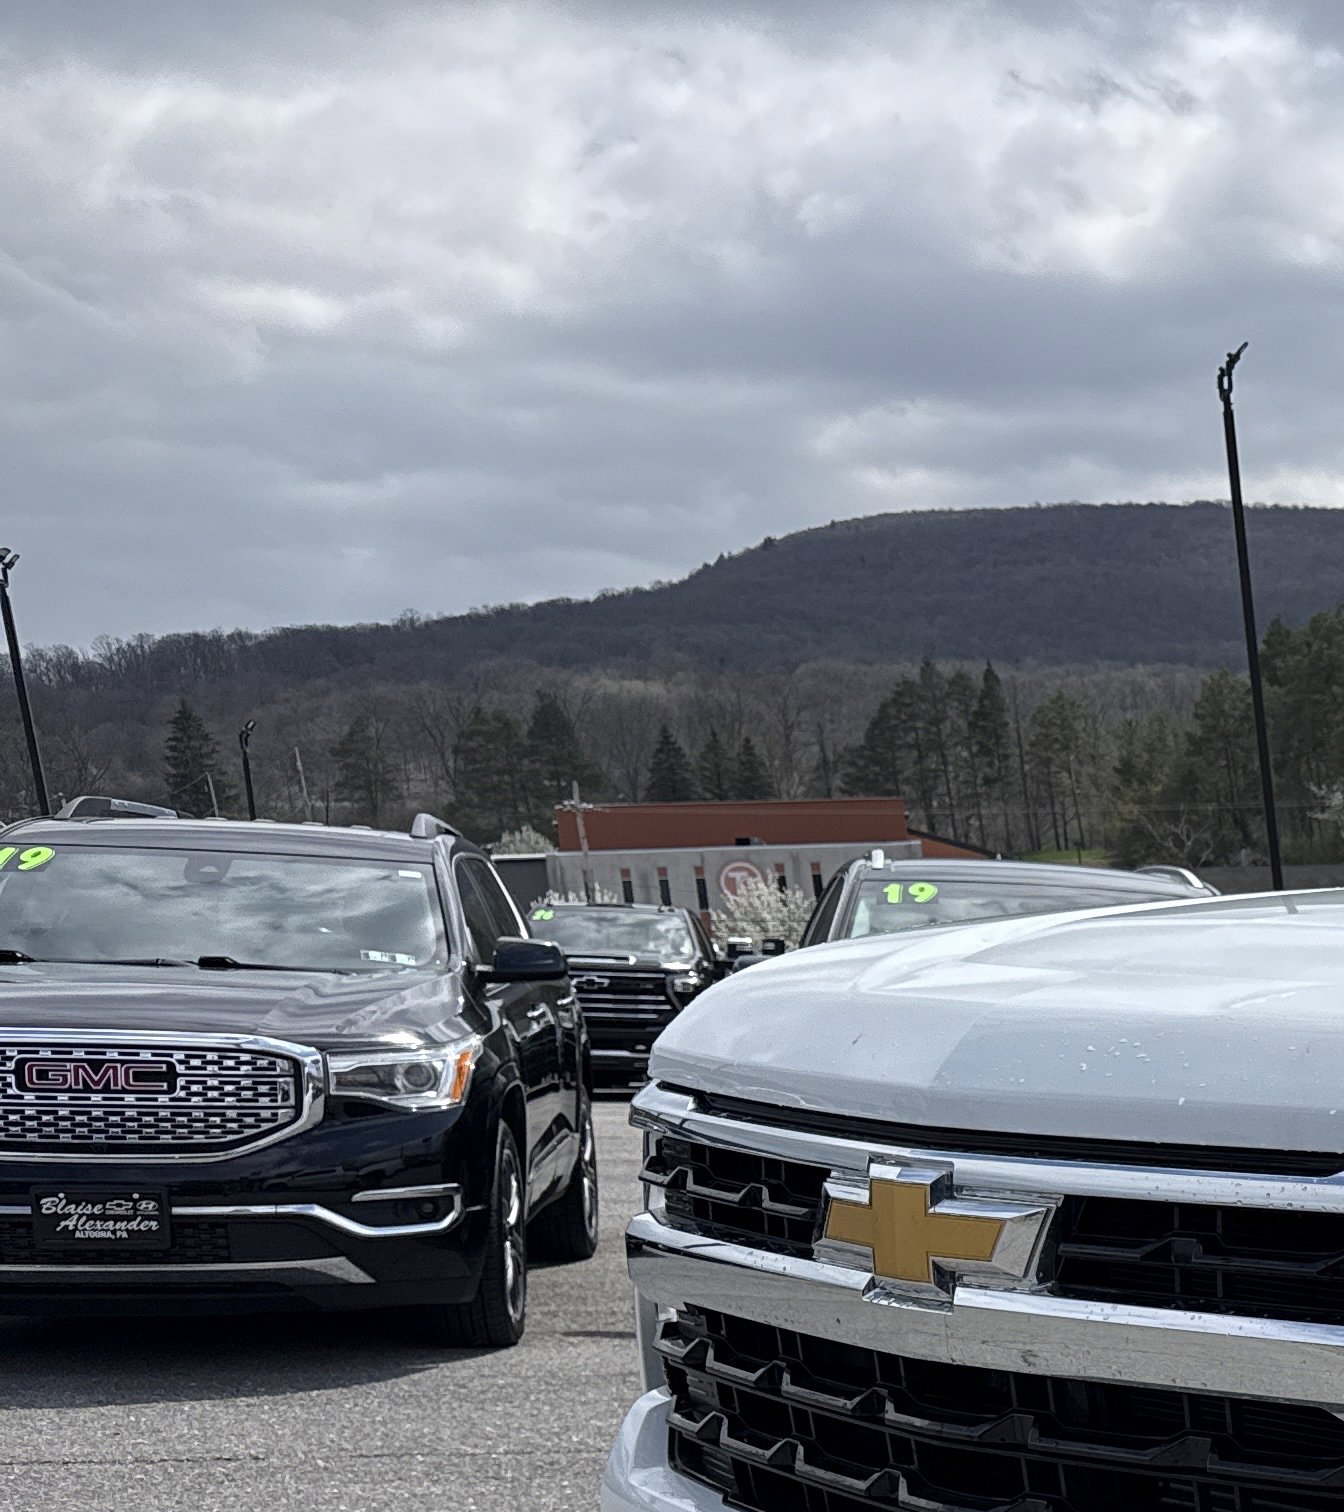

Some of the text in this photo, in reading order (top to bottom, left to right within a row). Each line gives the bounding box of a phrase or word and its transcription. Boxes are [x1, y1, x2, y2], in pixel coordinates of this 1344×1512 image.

[883, 882, 938, 903] 19
[25, 1062, 167, 1090] GMC
[40, 1196, 104, 1214] Blaise
[56, 1213, 160, 1232] Alexander
[116, 1230, 128, 1239] PA
